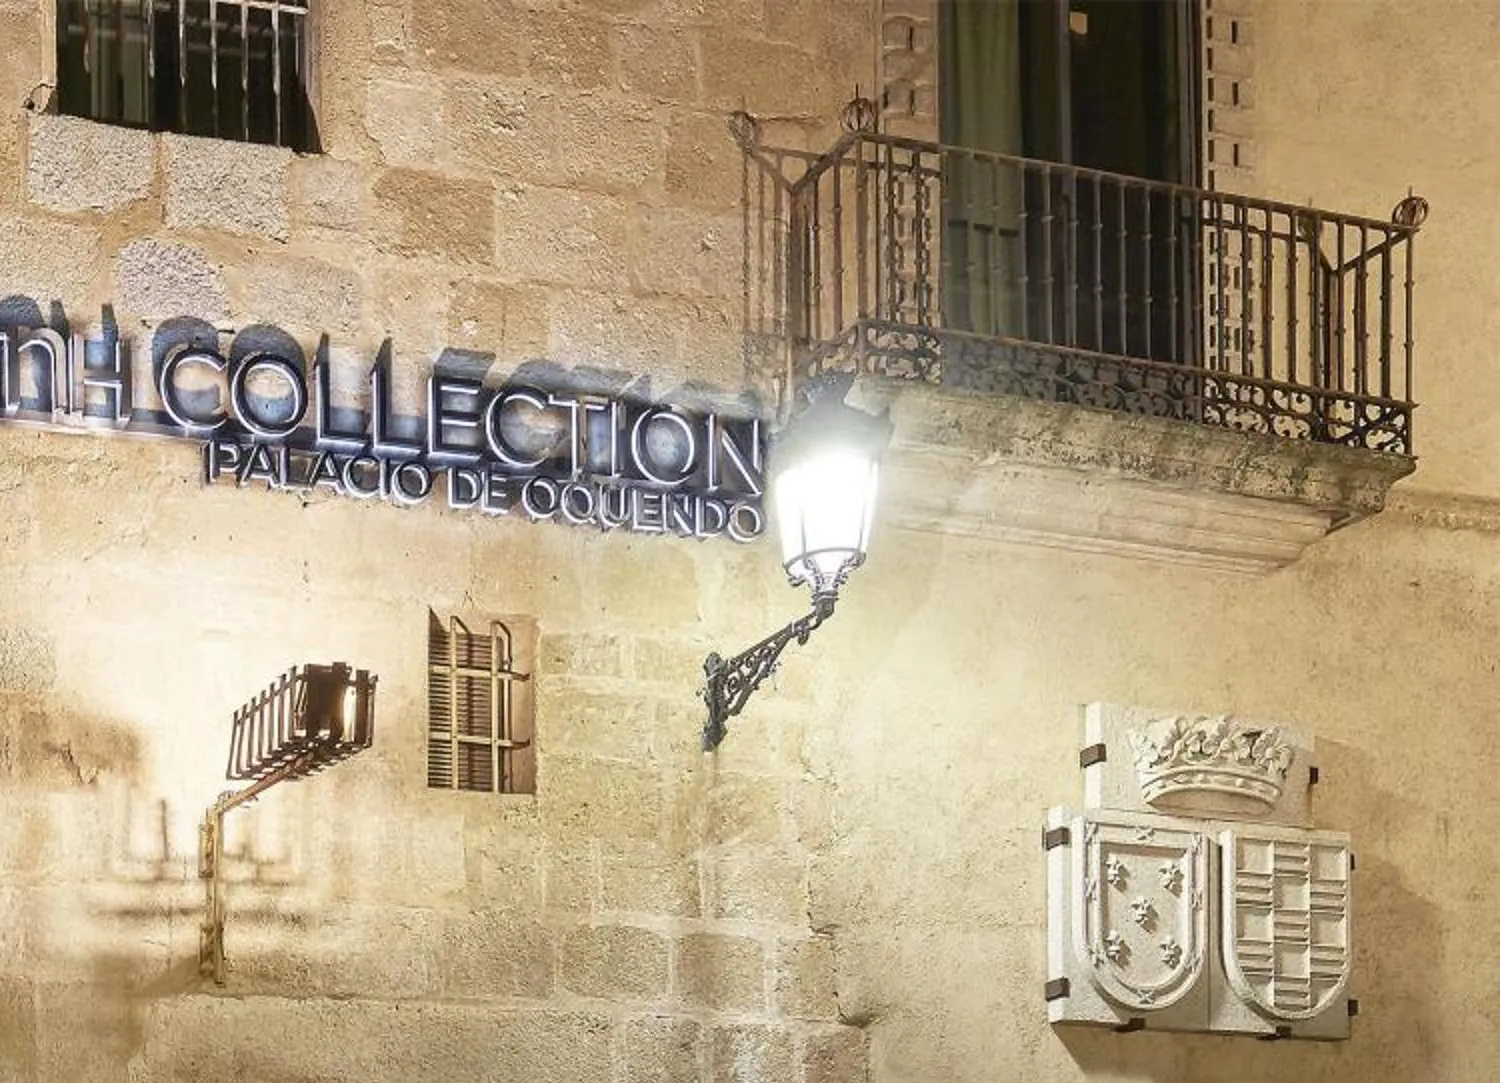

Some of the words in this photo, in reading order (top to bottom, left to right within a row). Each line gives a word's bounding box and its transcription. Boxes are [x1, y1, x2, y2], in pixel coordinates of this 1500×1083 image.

[160, 342, 764, 496] COLLECTION
[208, 440, 432, 502] PALACIO
[448, 467, 507, 515] DE
[521, 475, 762, 542] OQUENDO
